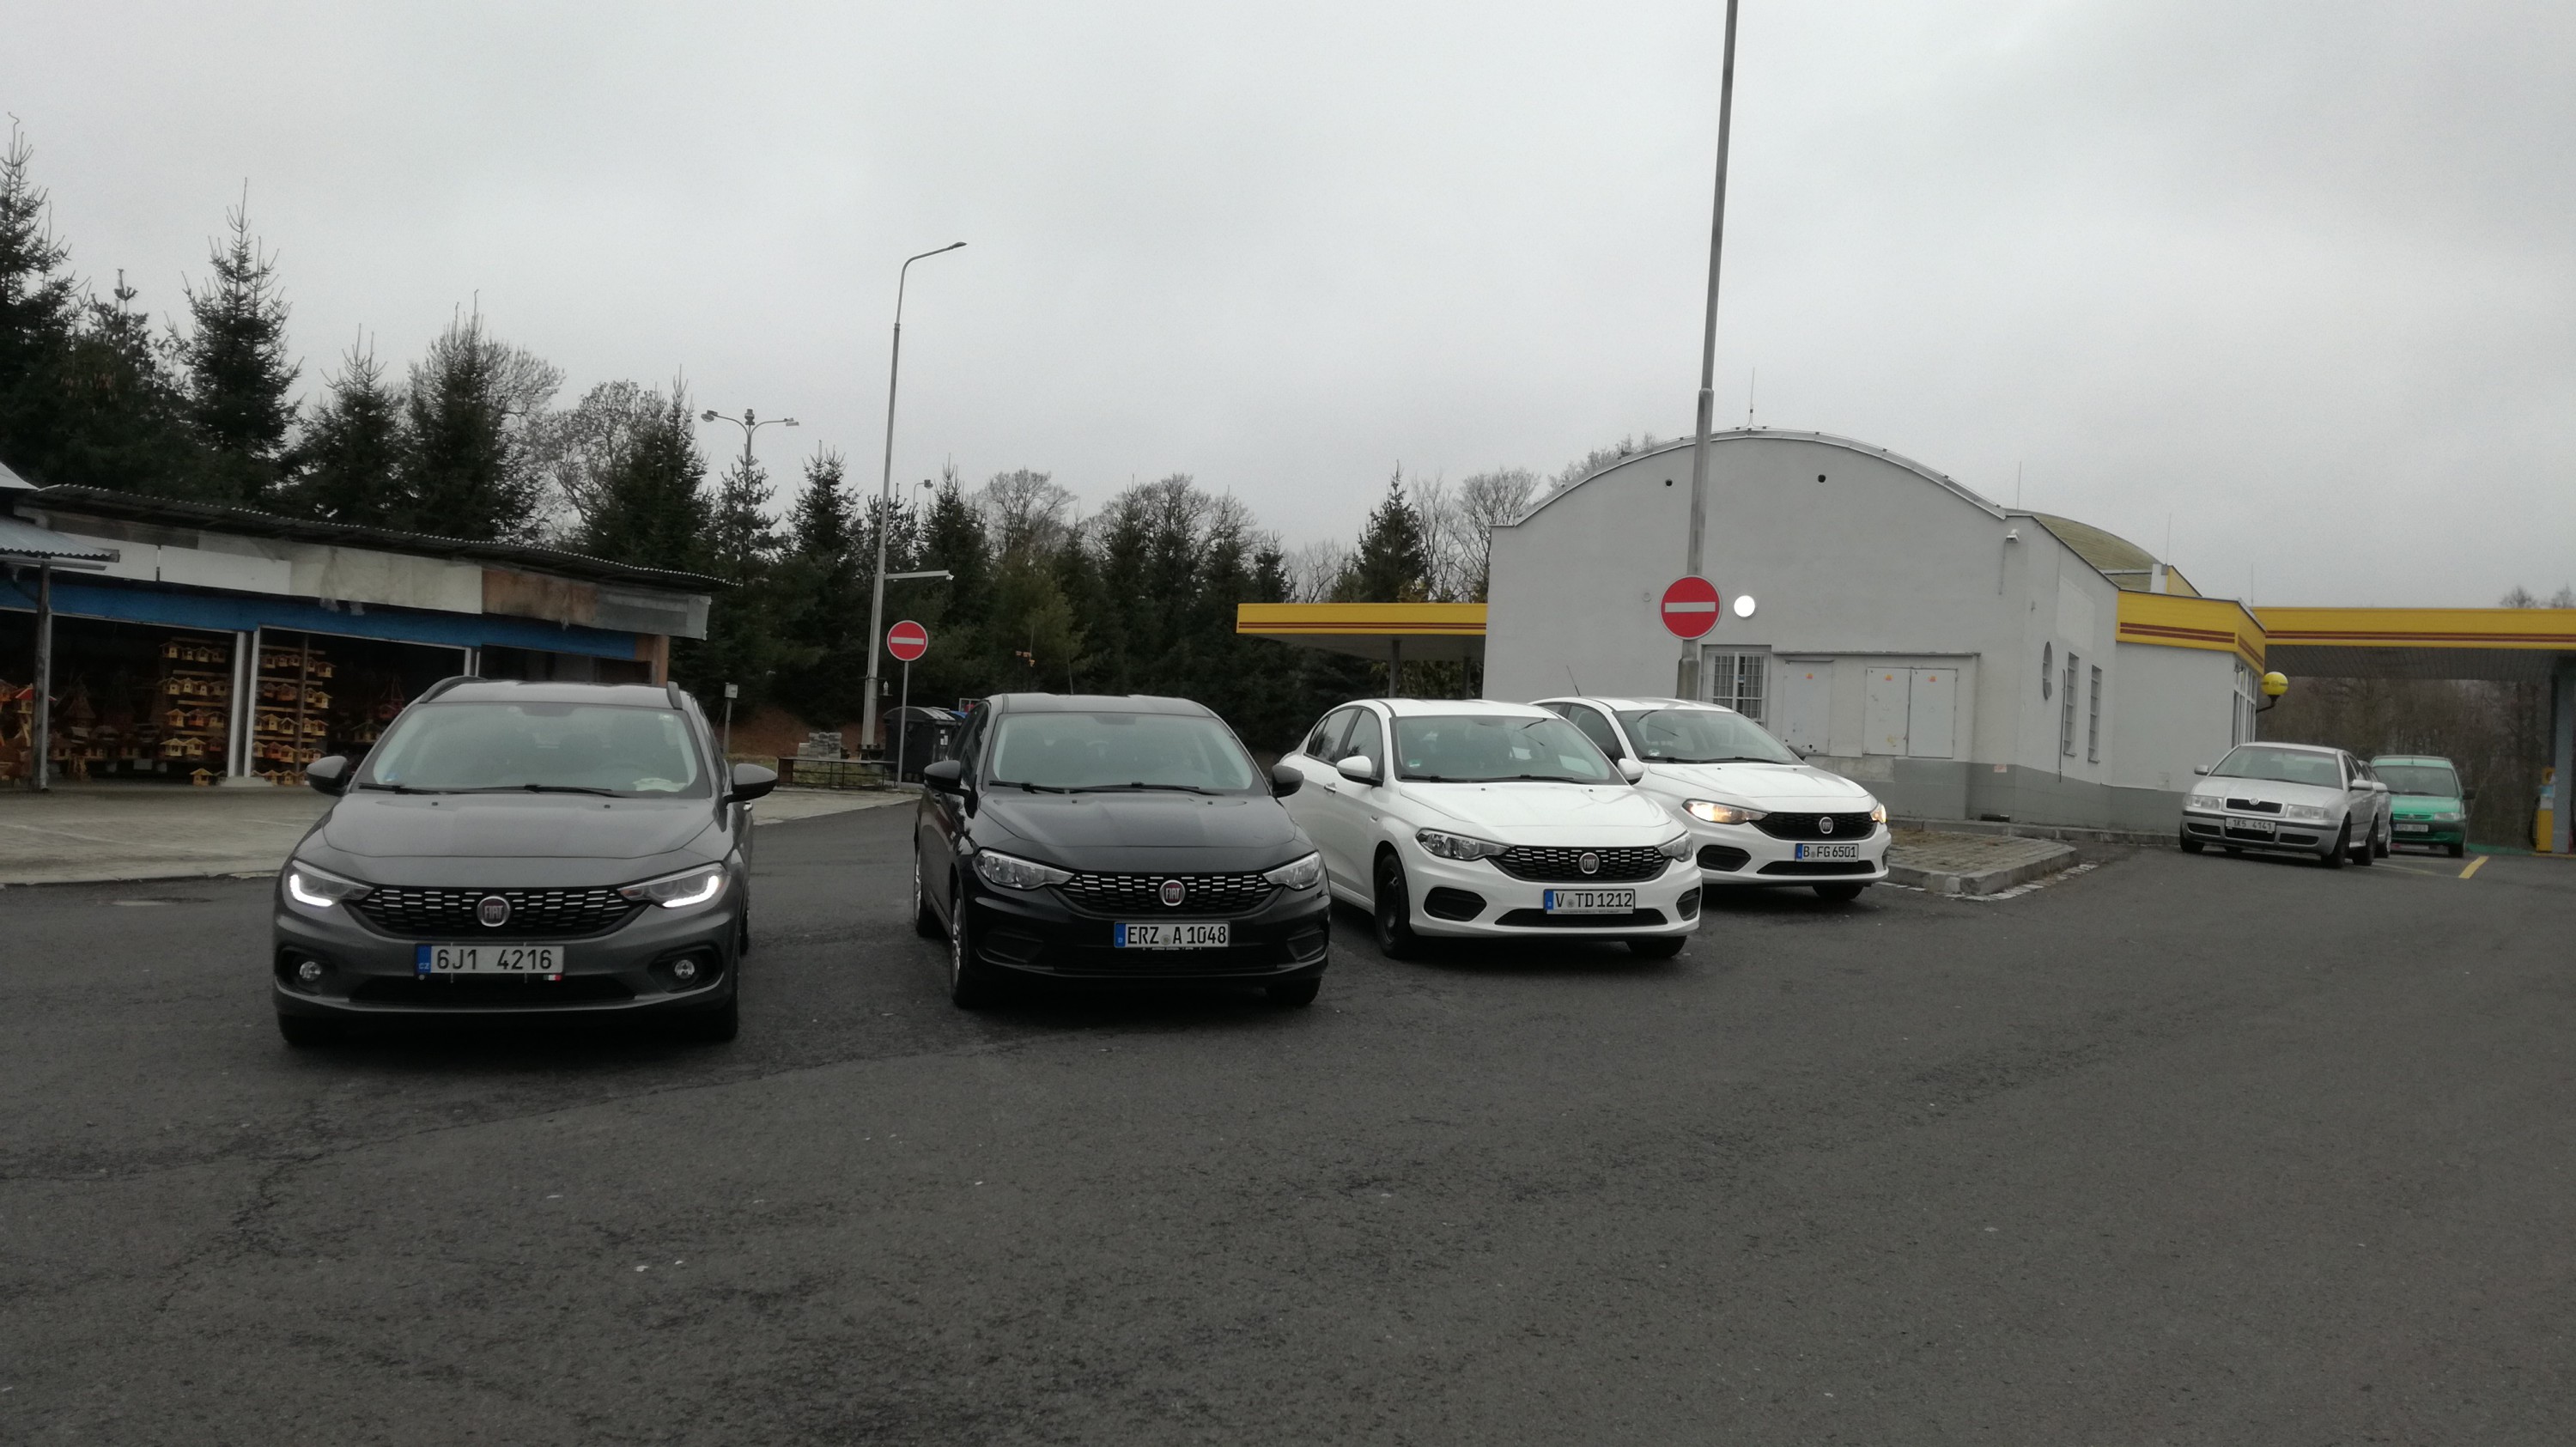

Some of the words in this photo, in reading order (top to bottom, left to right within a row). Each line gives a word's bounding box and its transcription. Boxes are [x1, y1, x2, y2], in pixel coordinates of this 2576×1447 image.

[2233, 819, 2247, 828] 1K5
[1803, 846, 1809, 857] B
[1817, 846, 1831, 857] FG
[1832, 846, 1856, 857] 6501
[1165, 887, 1181, 900] FIAT
[1556, 893, 1564, 908] V
[1575, 893, 1594, 908] TD
[1597, 893, 1632, 908] 1212
[484, 905, 504, 919] FIAT
[1127, 927, 1159, 945] ERZ
[1173, 927, 1182, 945] A
[1187, 927, 1226, 944] 1048
[437, 949, 477, 970] 6J1
[496, 949, 552, 970] 4216
